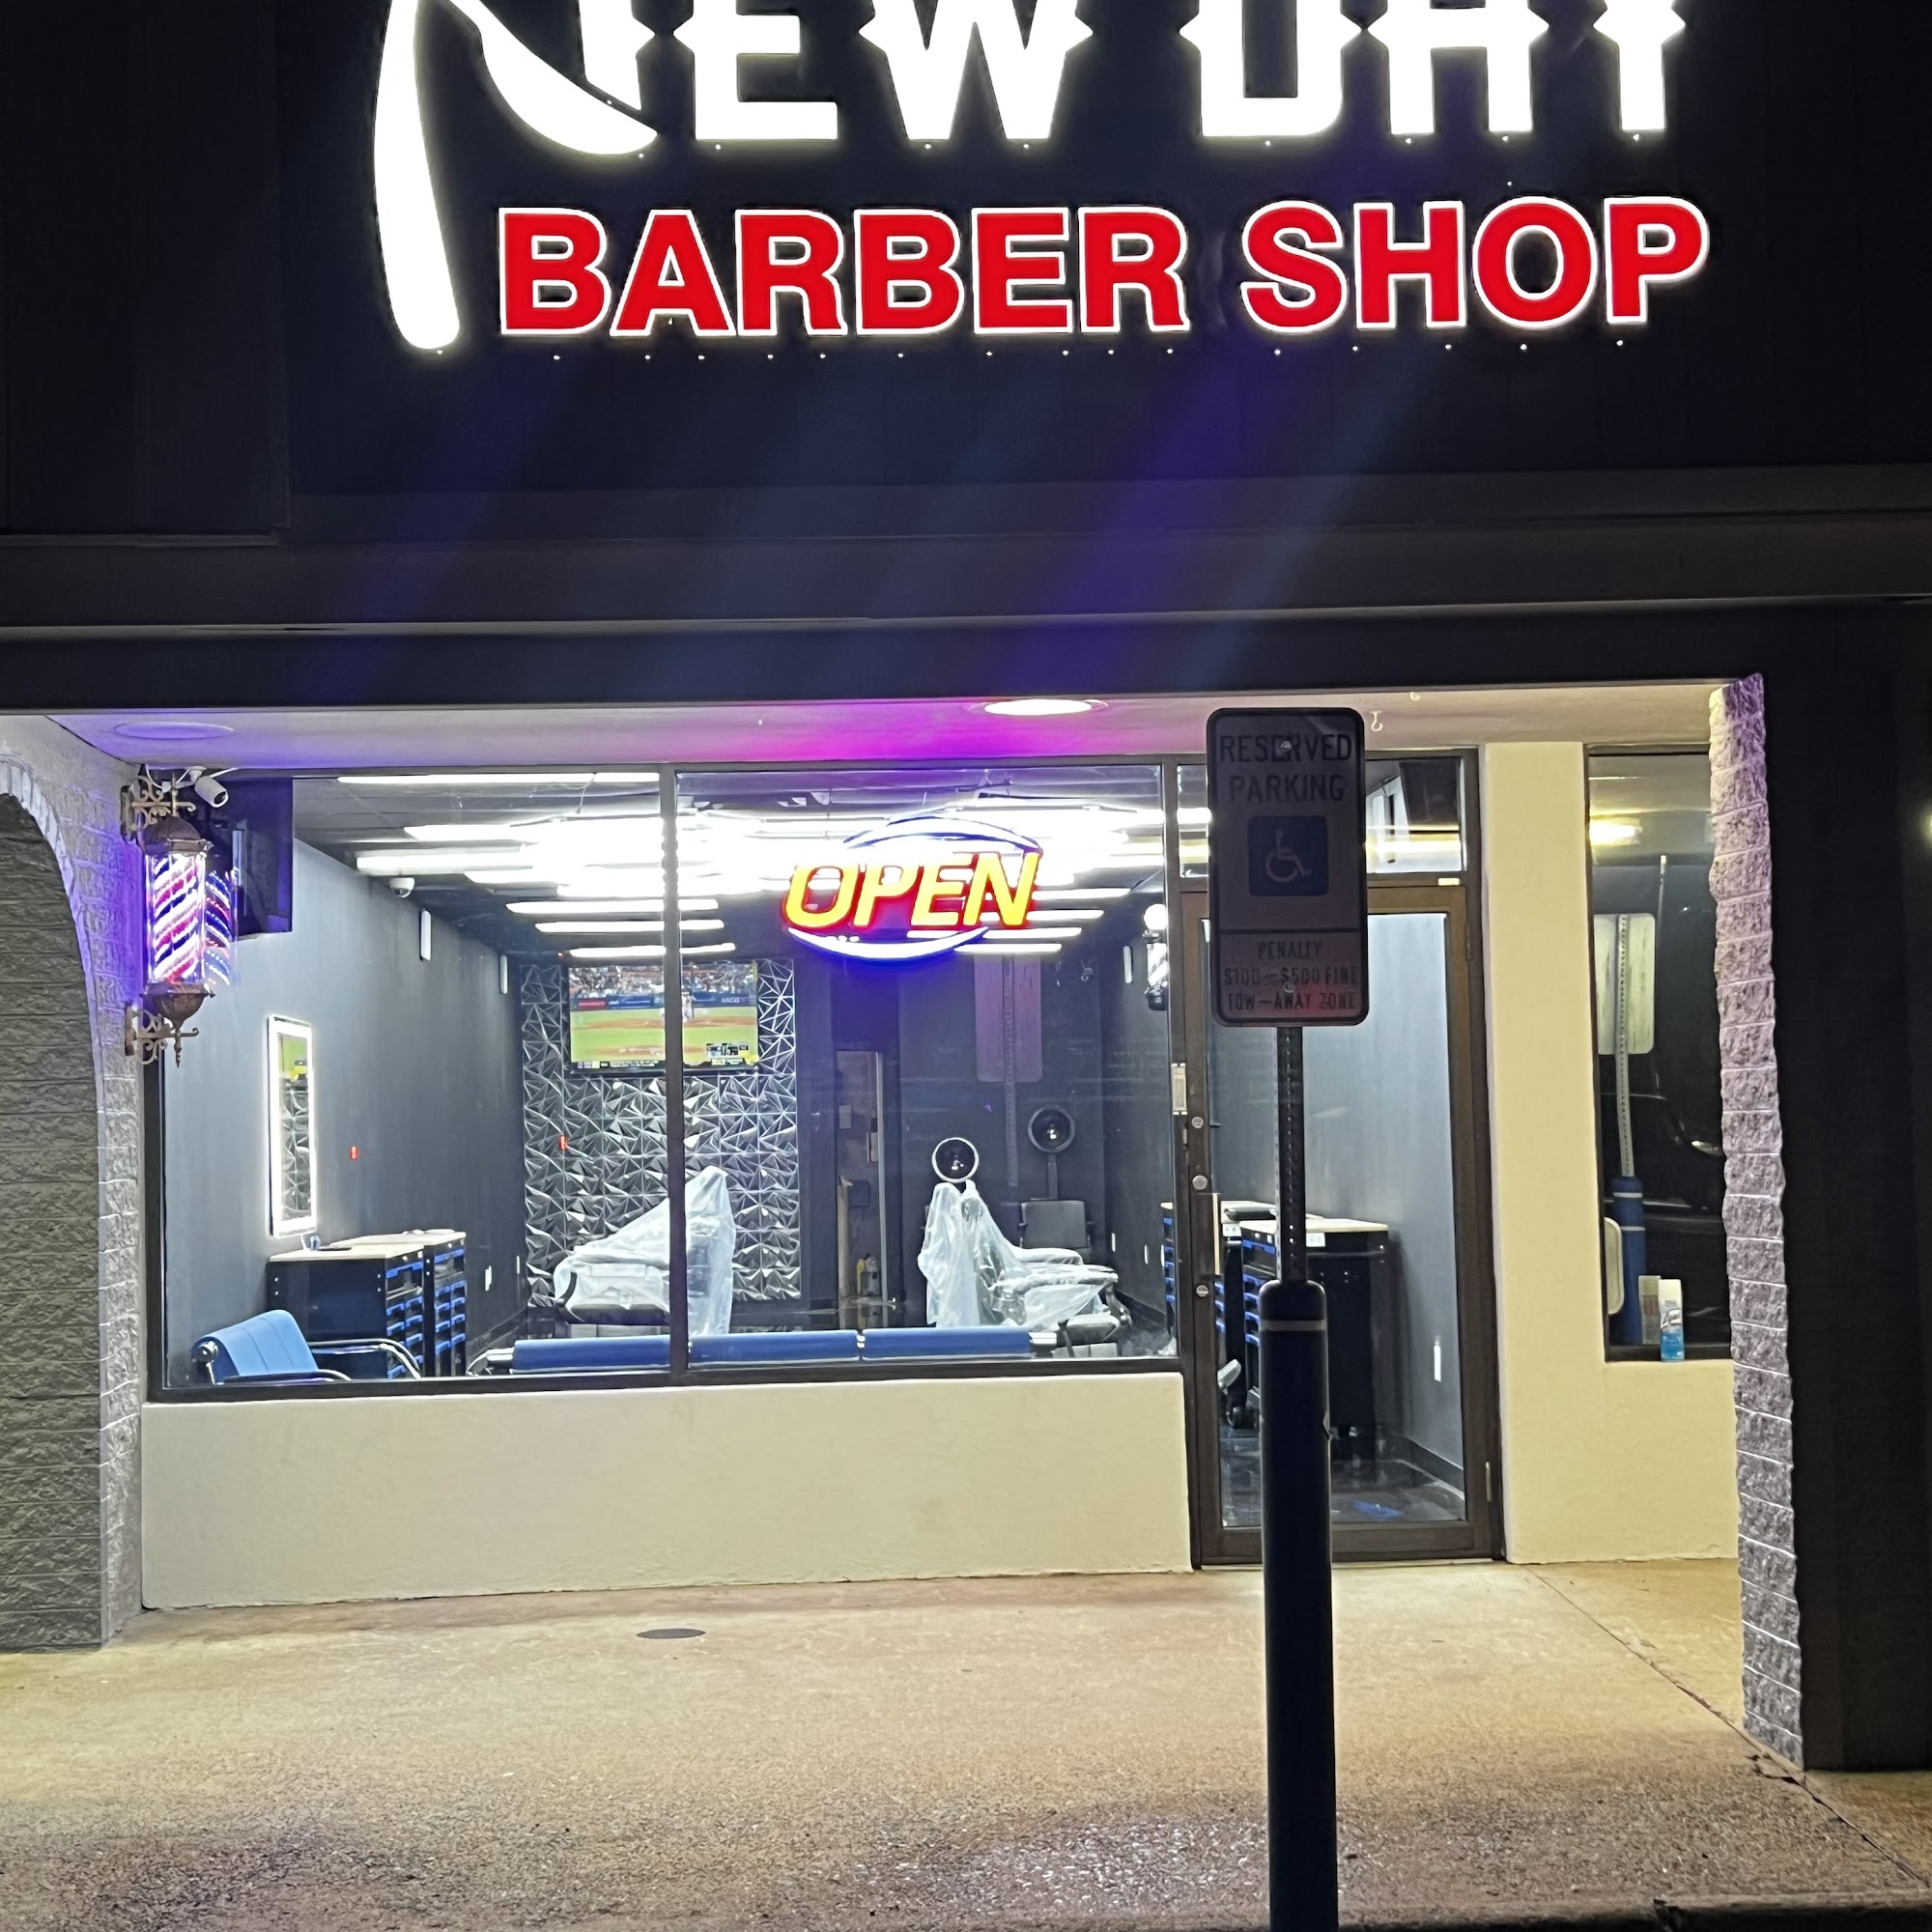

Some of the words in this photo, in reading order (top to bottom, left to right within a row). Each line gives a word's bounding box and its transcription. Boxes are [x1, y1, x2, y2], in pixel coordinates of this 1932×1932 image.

[498, 207, 1190, 337] BARBER
[1240, 196, 1710, 333] SHOP
[1219, 733, 1352, 763] RESERVED
[1229, 774, 1346, 804] PARKING
[782, 850, 1042, 929] OPEN
[1257, 941, 1322, 959] PENALTY
[1324, 965, 1359, 985] FINE
[1319, 991, 1358, 1010] ZONE
